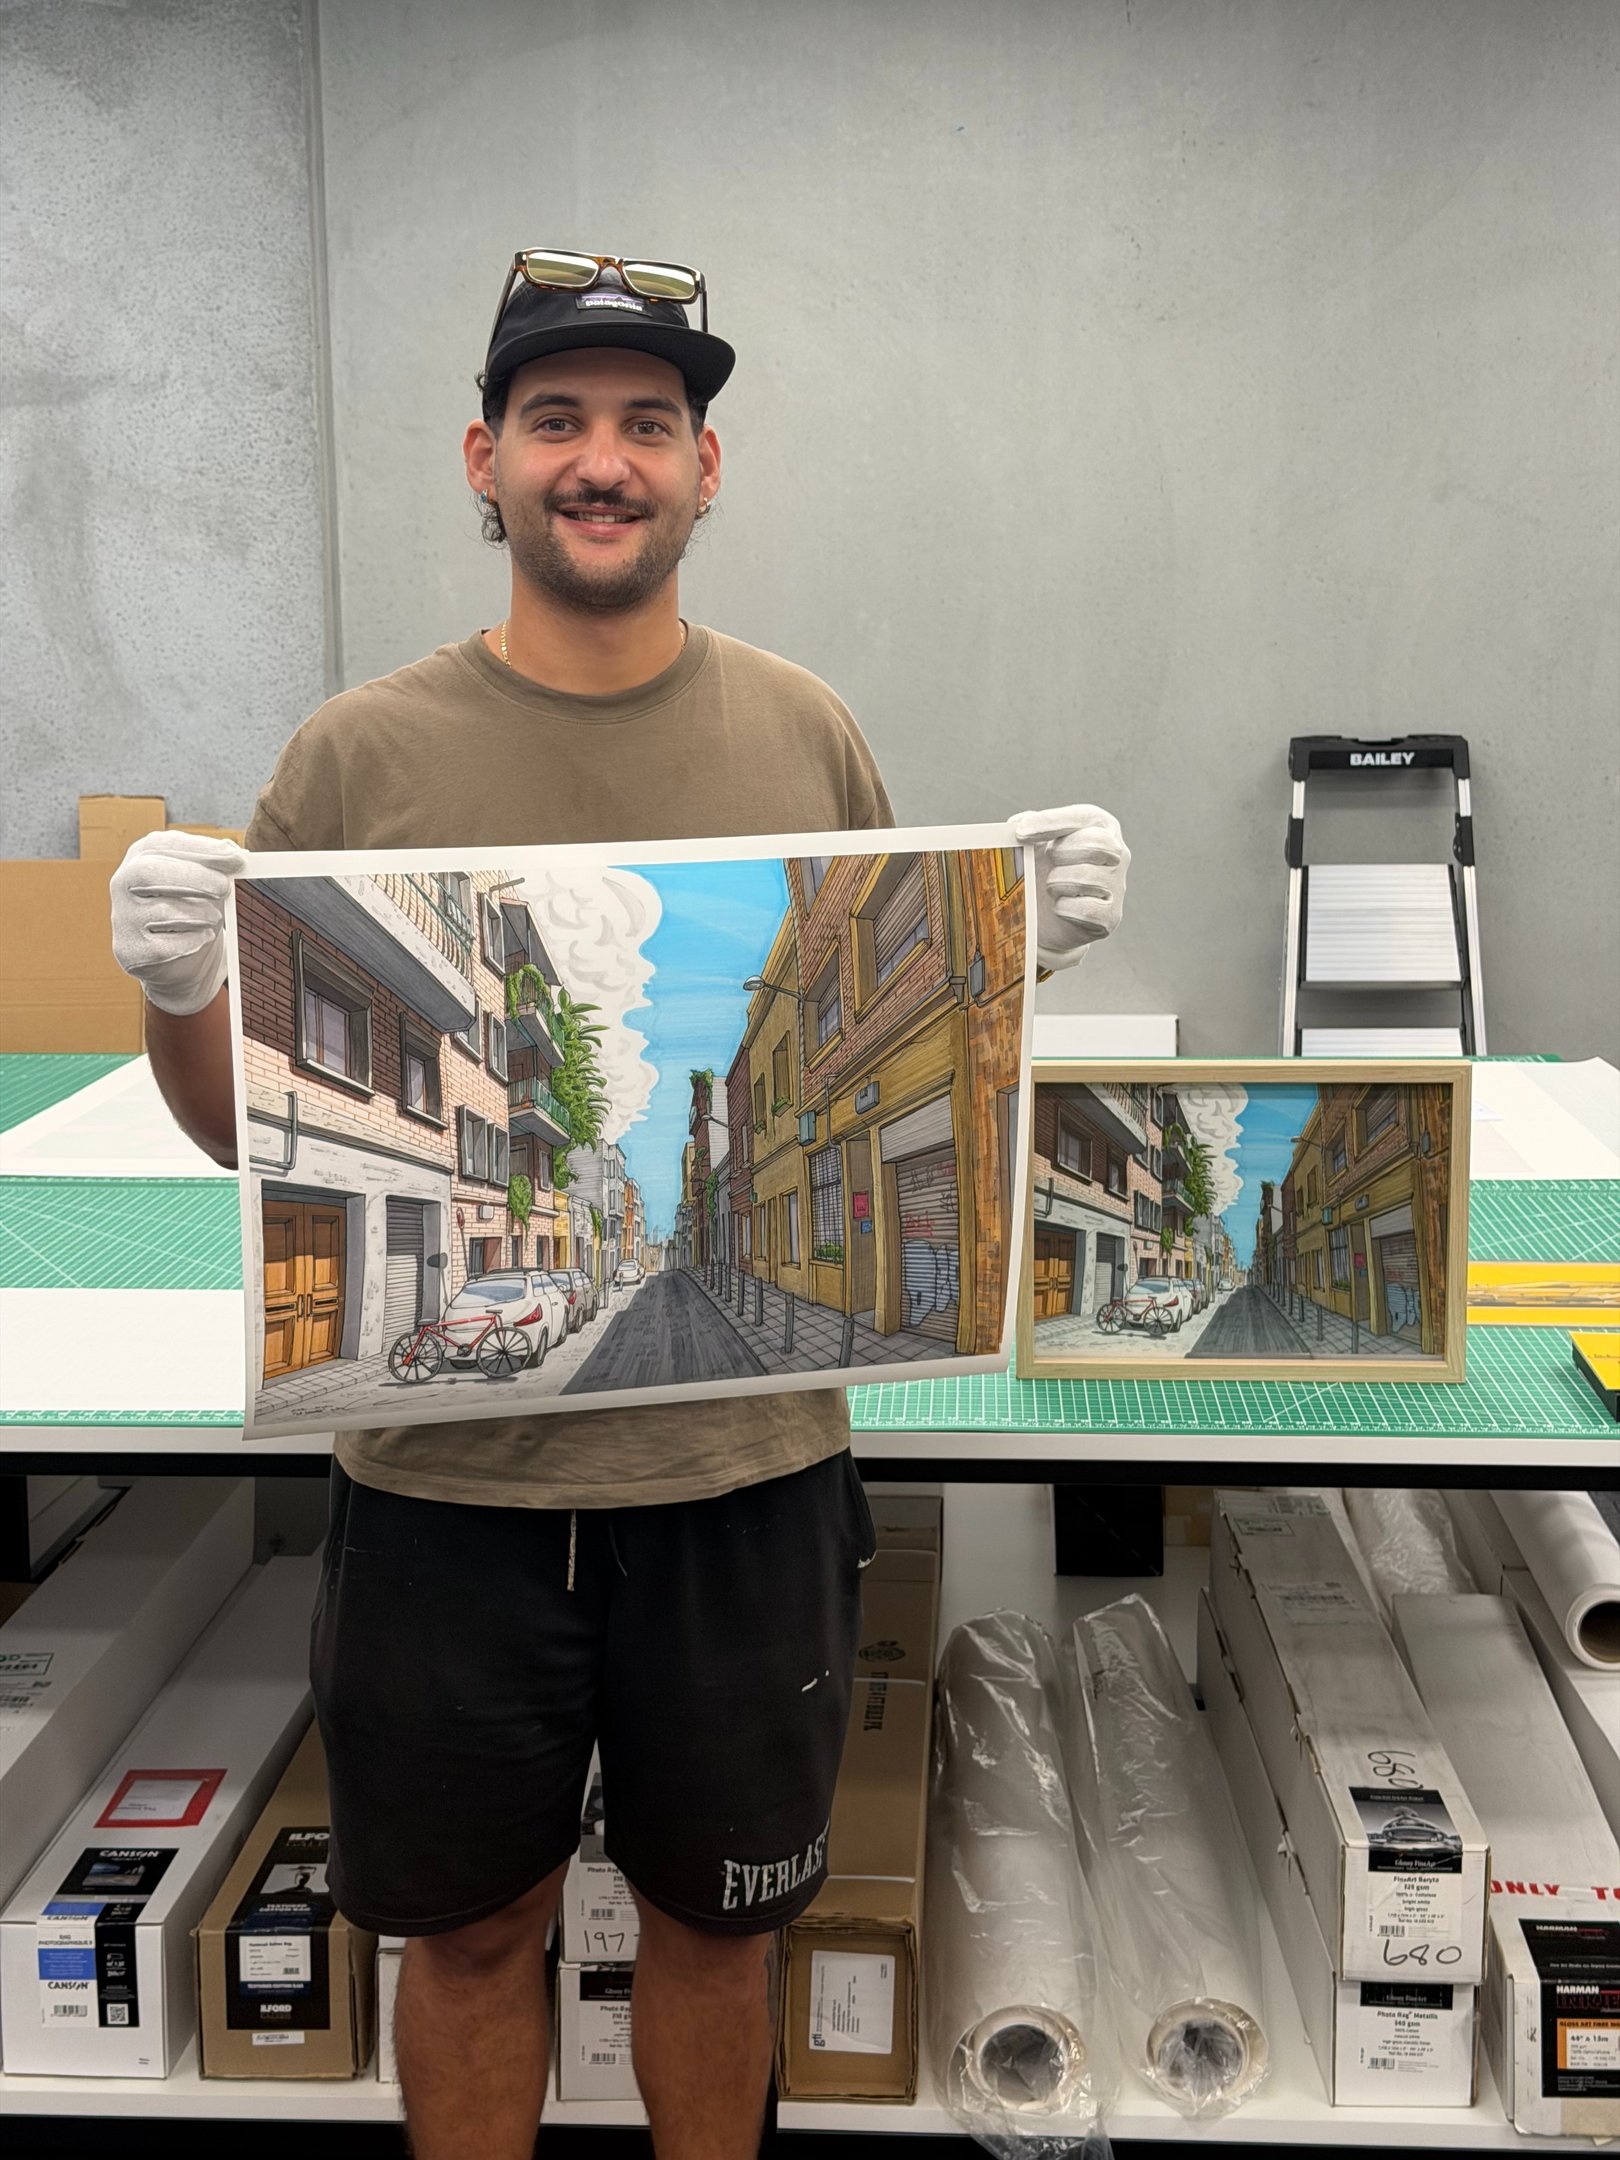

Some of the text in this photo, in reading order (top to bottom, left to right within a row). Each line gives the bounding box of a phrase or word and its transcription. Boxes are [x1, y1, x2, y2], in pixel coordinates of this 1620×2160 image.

[585, 299, 643, 312] patagonia
[1350, 752, 1415, 766] BAILEY
[288, 1832, 331, 1841] ILFO
[99, 1849, 160, 1858] CANSON
[722, 1818, 829, 1911] EVERLAS
[1418, 1876, 1440, 1884] Baryta
[1416, 1884, 1430, 1892] gsm
[583, 1929, 625, 1954] 197
[1383, 1939, 1462, 1966] 680
[47, 1981, 89, 1990] CANSON
[1556, 1984, 1600, 1994] HARMAN
[260, 2004, 293, 2013] ILFORD
[1376, 2010, 1396, 2018] Photo
